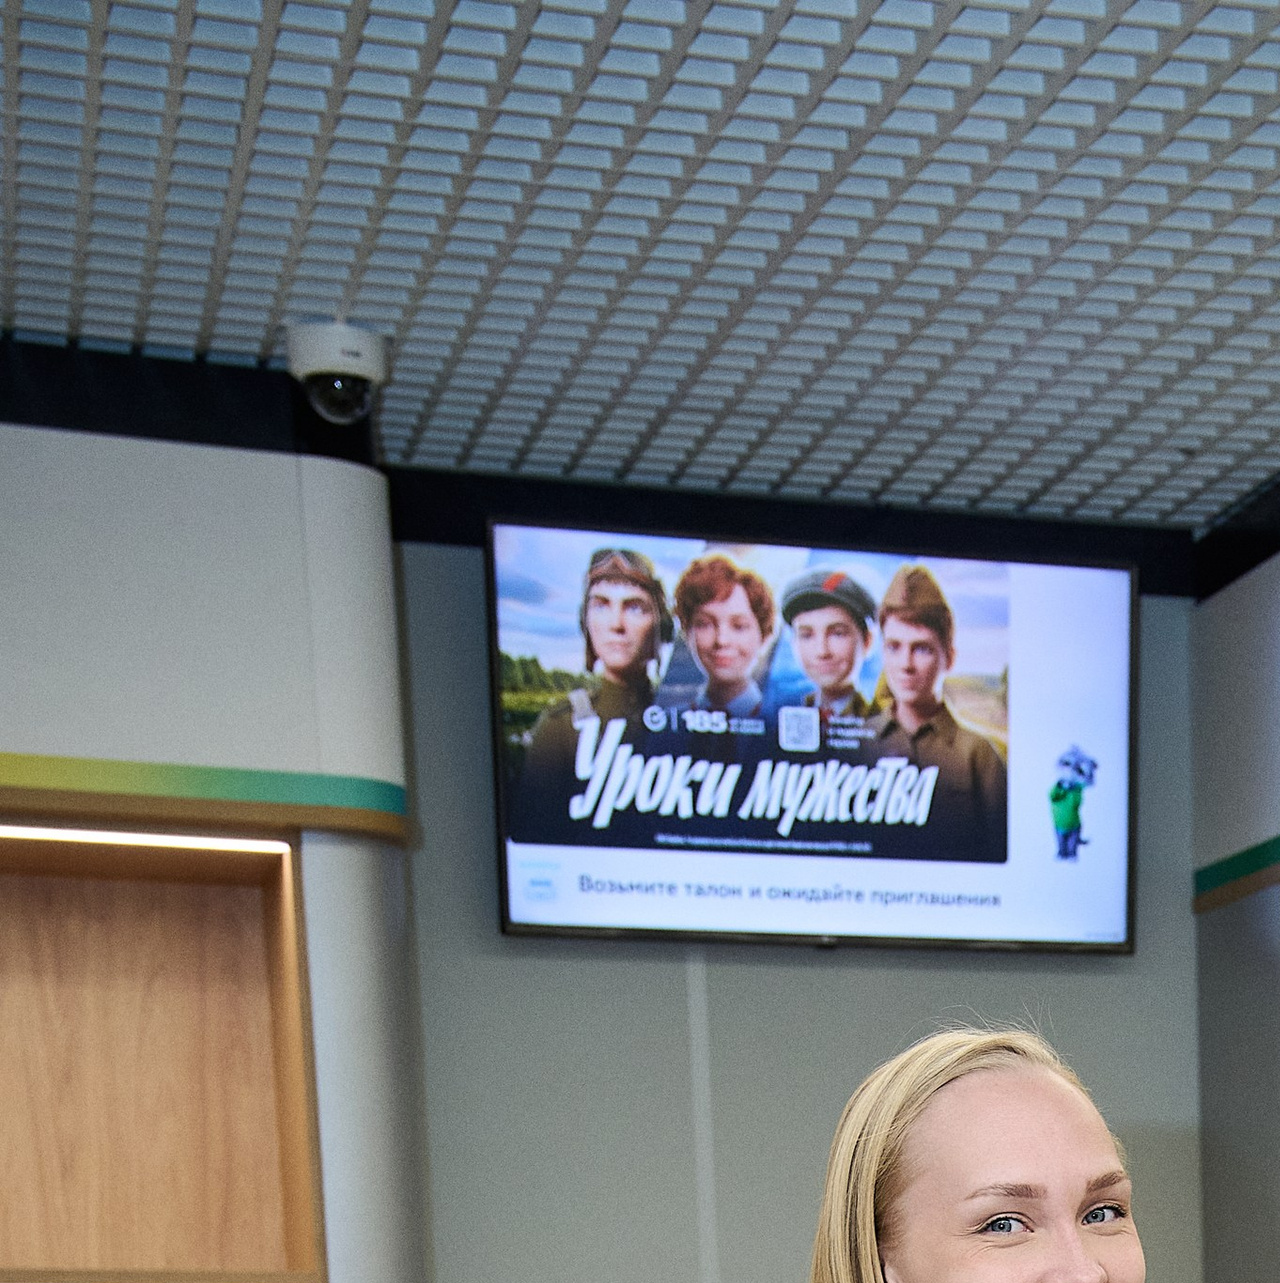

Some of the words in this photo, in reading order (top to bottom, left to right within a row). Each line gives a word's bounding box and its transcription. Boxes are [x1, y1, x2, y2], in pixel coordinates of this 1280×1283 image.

[568, 715, 742, 829] Уроки
[737, 756, 940, 837] мужества
[578, 872, 679, 894] Возьмите
[684, 883, 743, 898] талон
[748, 885, 761, 899] и
[766, 882, 865, 904] ожидайте
[870, 888, 1002, 907] приглашения
